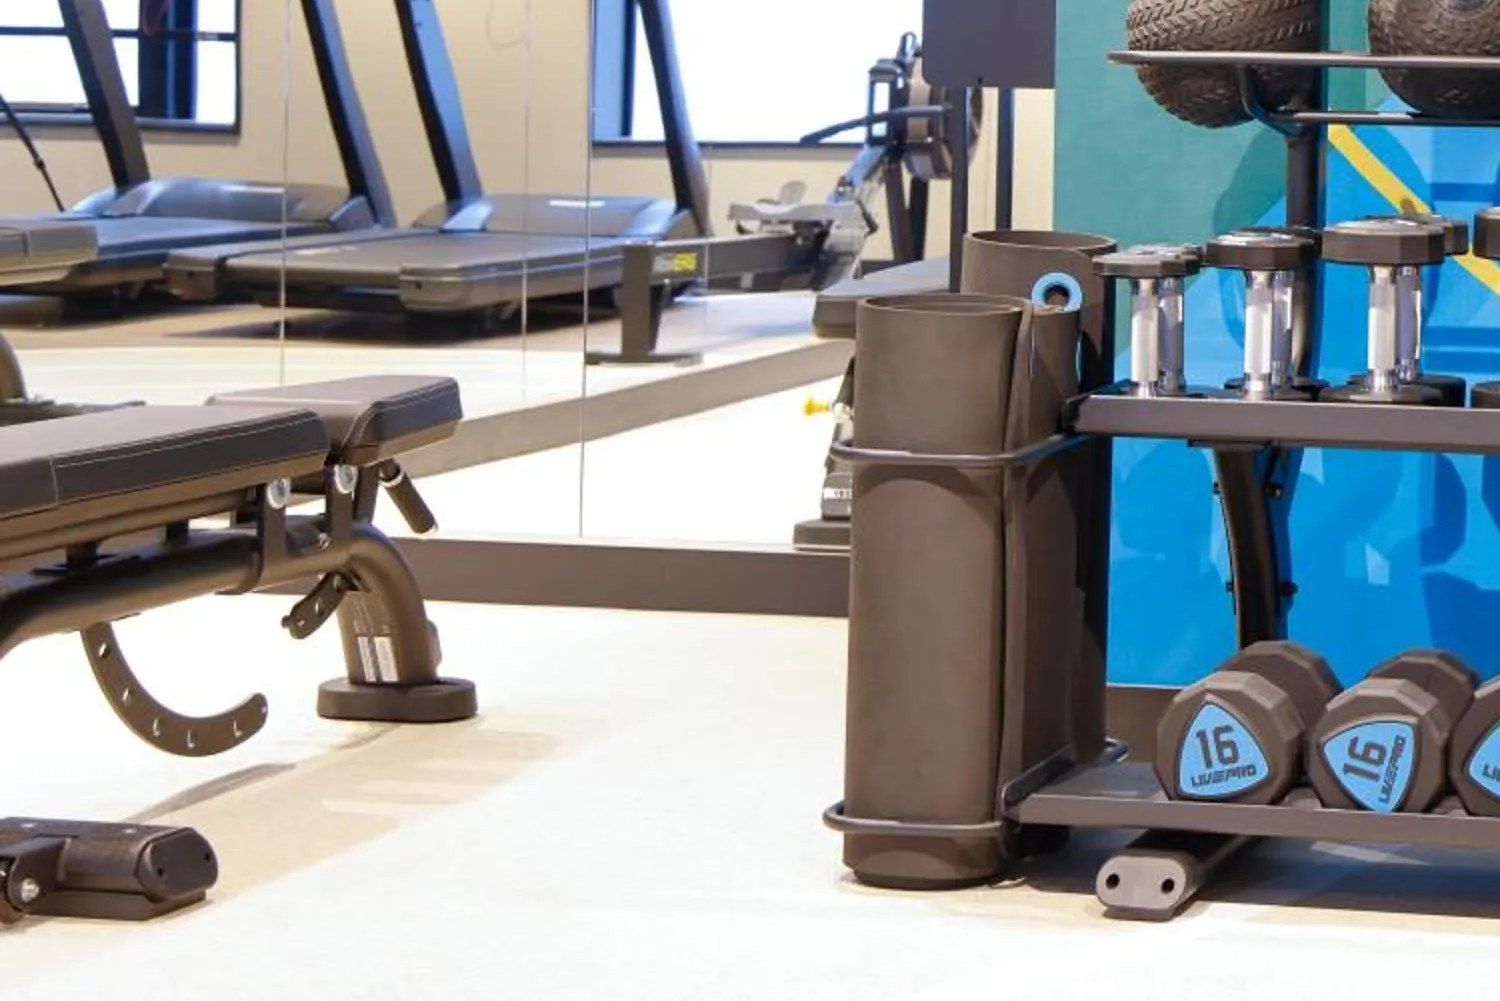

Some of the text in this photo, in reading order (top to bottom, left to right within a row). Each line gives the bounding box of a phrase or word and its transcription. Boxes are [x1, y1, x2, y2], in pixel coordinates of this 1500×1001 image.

[1196, 725, 1240, 769] 16
[1343, 736, 1387, 783] 16
[1190, 764, 1256, 787] LIVEPRO
